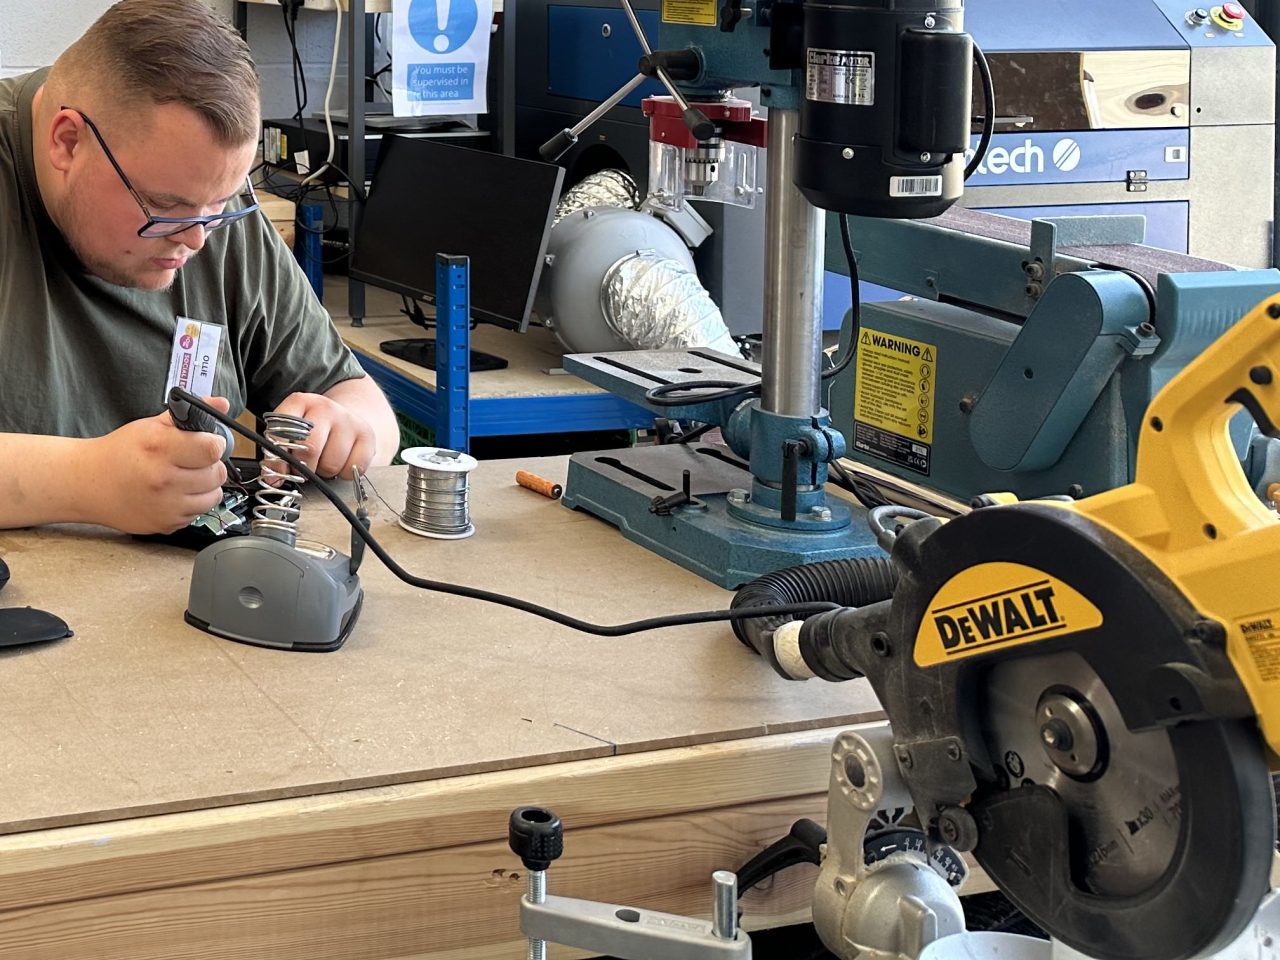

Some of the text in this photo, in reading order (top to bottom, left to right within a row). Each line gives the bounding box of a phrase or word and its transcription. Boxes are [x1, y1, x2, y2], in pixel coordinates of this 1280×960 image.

[809, 50, 841, 66] Clarke
[414, 65, 468, 75] You must be
[412, 77, 469, 90] supervised in
[422, 89, 459, 98] this area
[871, 334, 921, 357] WARNING
[180, 354, 190, 378] SOCIAL
[200, 354, 210, 377] OLLIE
